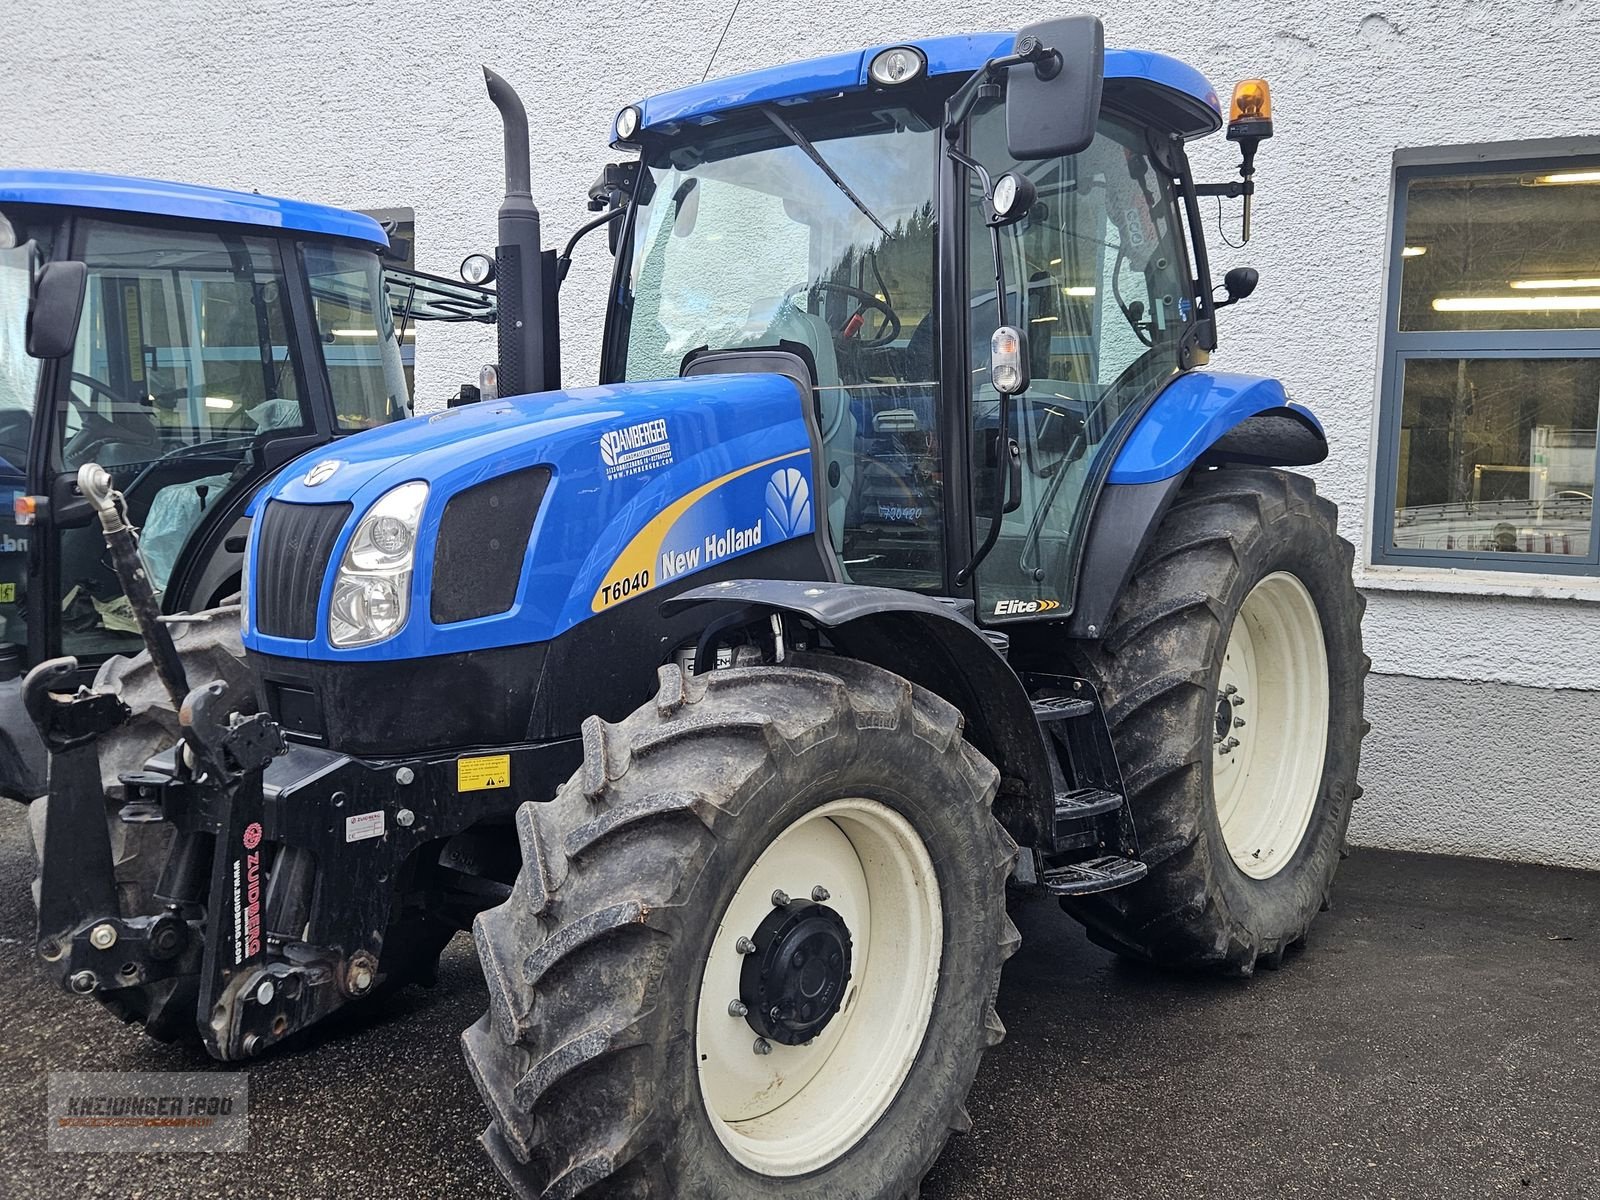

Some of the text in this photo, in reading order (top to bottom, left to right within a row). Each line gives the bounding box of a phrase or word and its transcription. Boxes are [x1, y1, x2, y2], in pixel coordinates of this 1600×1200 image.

[609, 419, 668, 466] PAMBERGER
[661, 519, 762, 580] New Holland
[601, 570, 649, 605] T6040
[994, 599, 1038, 616] Elite
[233, 860, 242, 965] WWW.ZUIDBERG.COM
[247, 851, 261, 957] ZUIDBERG
